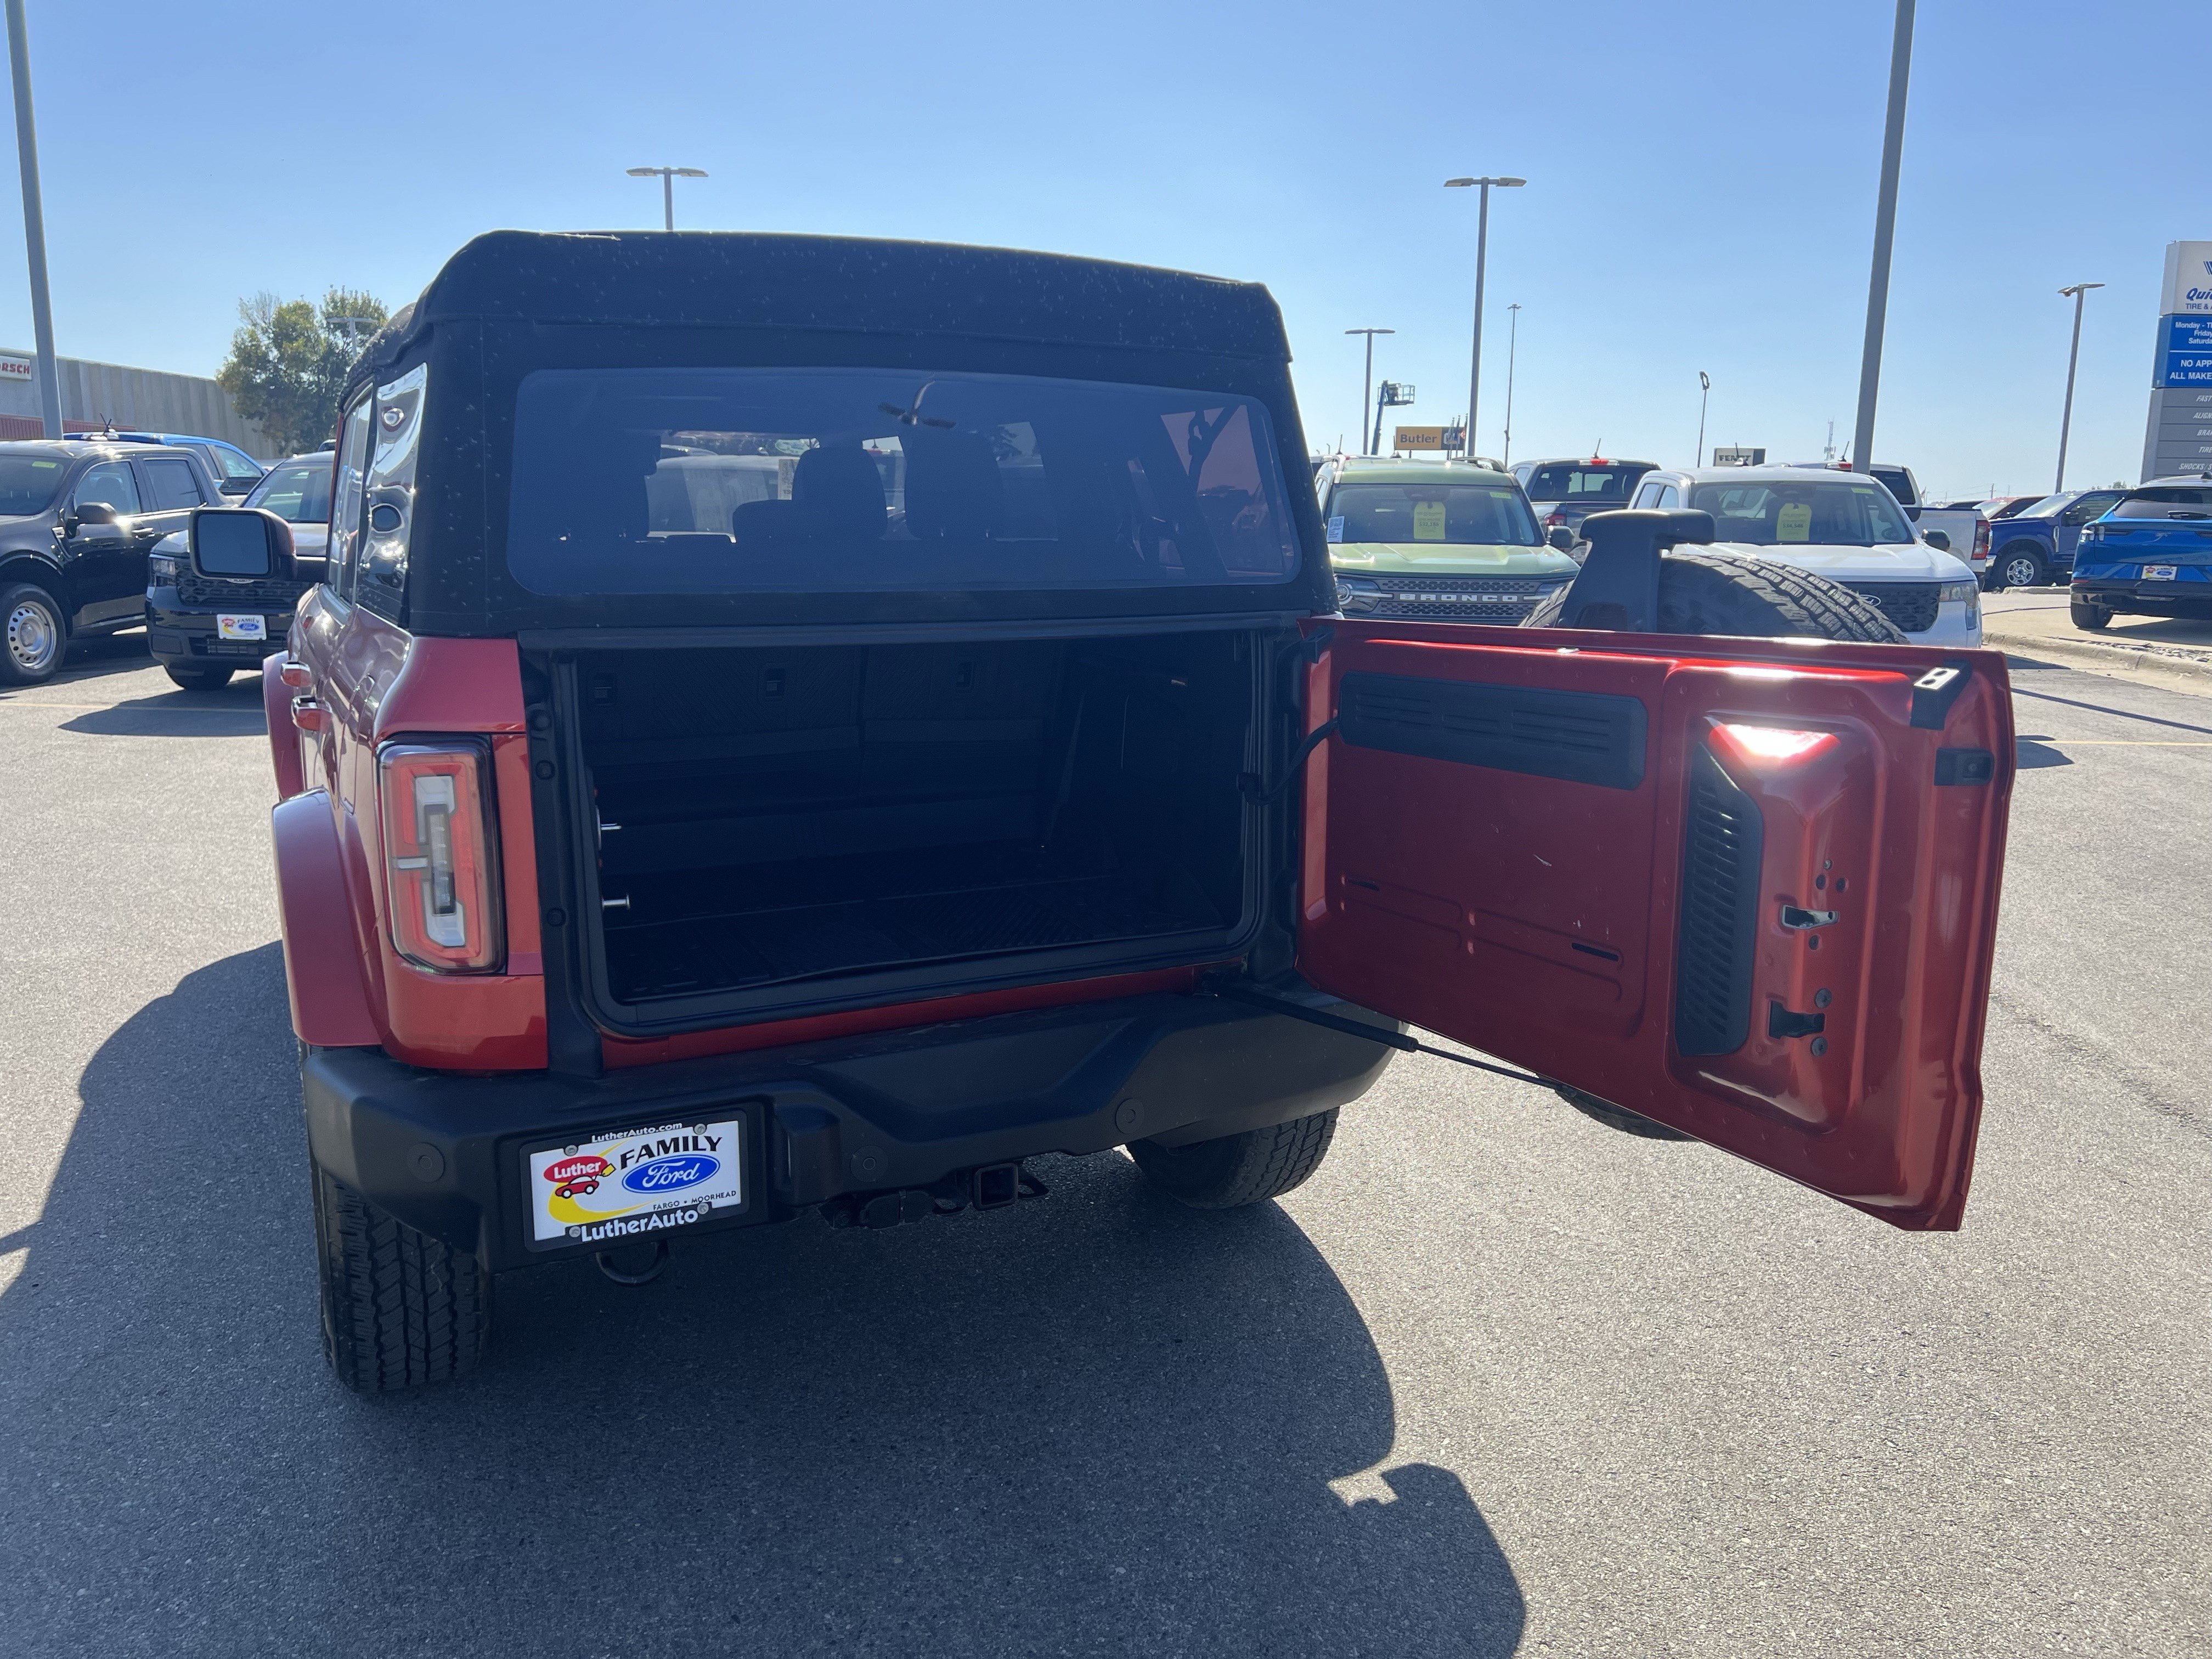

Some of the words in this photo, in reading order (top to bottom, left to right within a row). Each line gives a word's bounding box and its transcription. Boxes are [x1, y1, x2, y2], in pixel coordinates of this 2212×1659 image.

[2175, 321, 2200, 330] Monday
[0, 363, 30, 374] RSCH
[1400, 434, 1437, 443] Butler
[1400, 593, 1518, 602] BRONCO
[591, 1122, 683, 1143] LutherAuto.com
[620, 1135, 723, 1170] FAMILY
[554, 1161, 602, 1179] Luther
[642, 1160, 701, 1188] Ford
[653, 1200, 680, 1211] FARGO
[691, 1190, 737, 1204] MOORHEAD
[580, 1209, 699, 1242] LutherAuto
